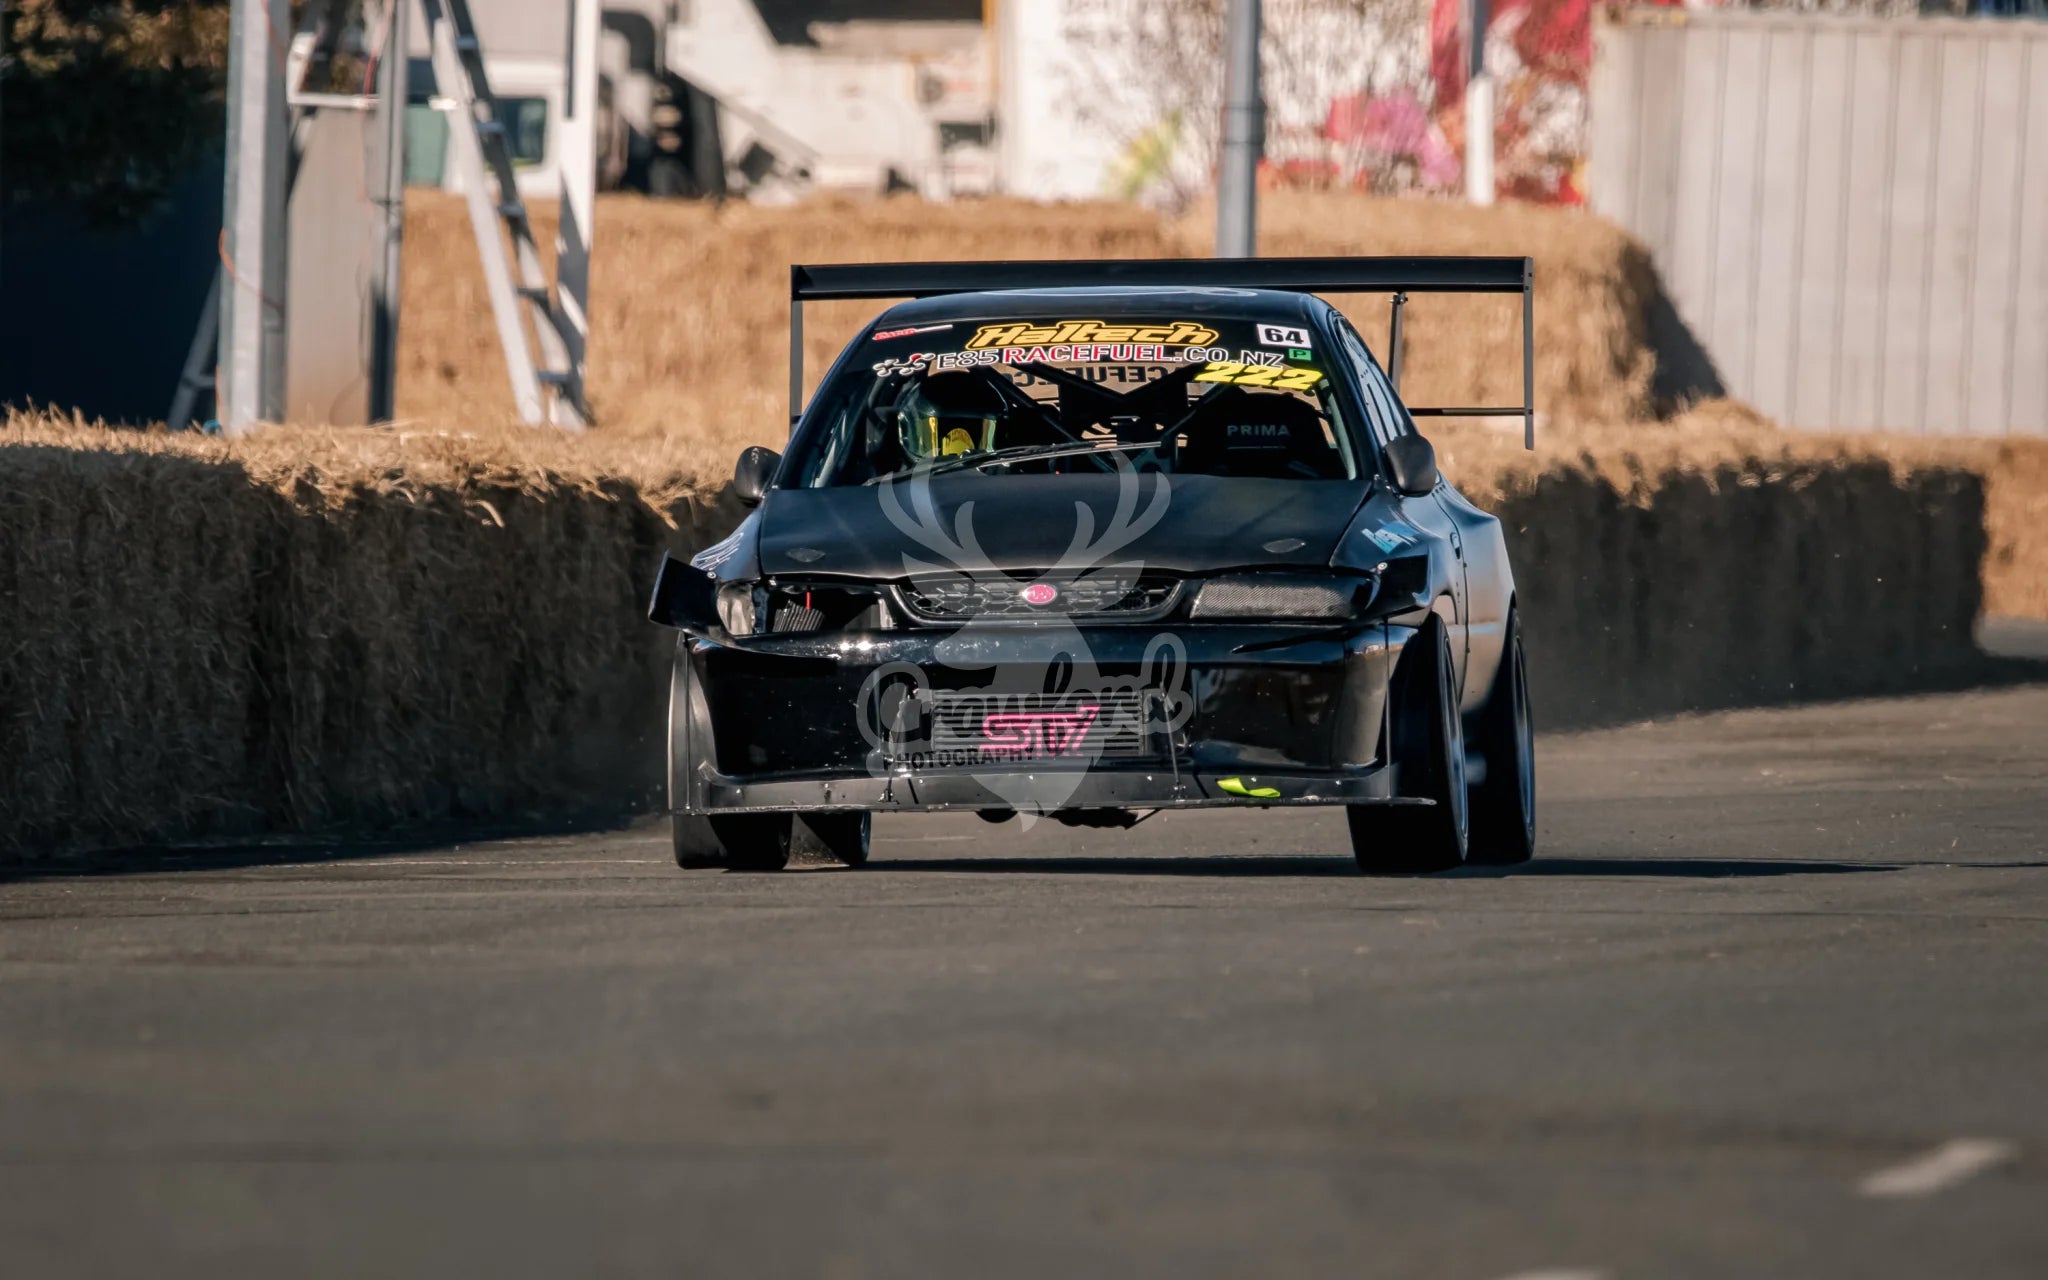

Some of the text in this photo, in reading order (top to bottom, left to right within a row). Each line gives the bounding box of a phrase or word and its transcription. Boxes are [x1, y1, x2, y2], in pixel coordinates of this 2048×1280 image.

[966, 321, 1218, 349] Haltech
[1265, 328, 1305, 344] 64
[937, 345, 1284, 369] E85RACEFUEL.CO.NZ
[1194, 361, 1323, 391] 222
[1226, 424, 1291, 437] PRIMA
